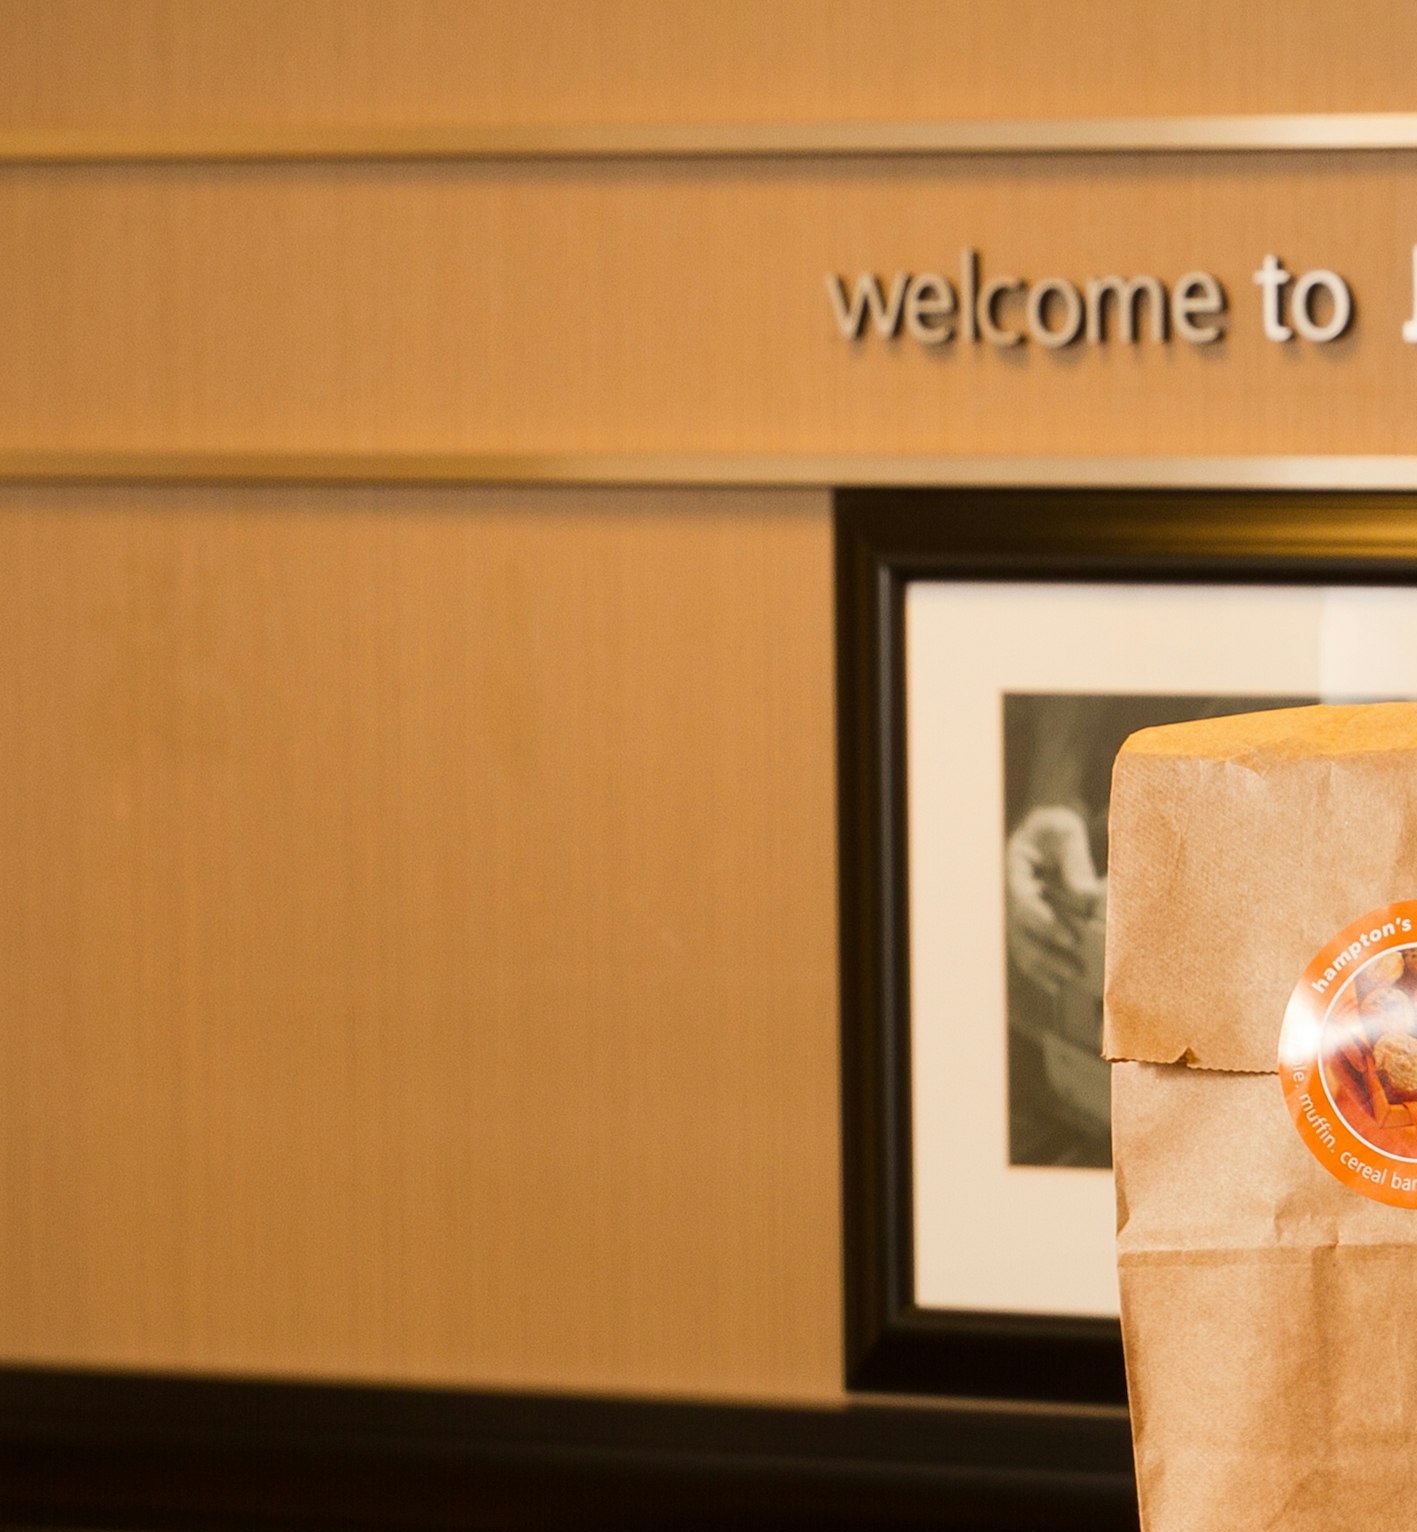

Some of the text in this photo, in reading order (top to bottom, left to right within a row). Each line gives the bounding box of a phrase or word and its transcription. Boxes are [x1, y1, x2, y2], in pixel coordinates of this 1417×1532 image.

[828, 248, 1226, 348] welcome
[1255, 254, 1352, 343] to
[1299, 1093, 1336, 1153] muffin.
[1339, 1150, 1387, 1185] cereal
